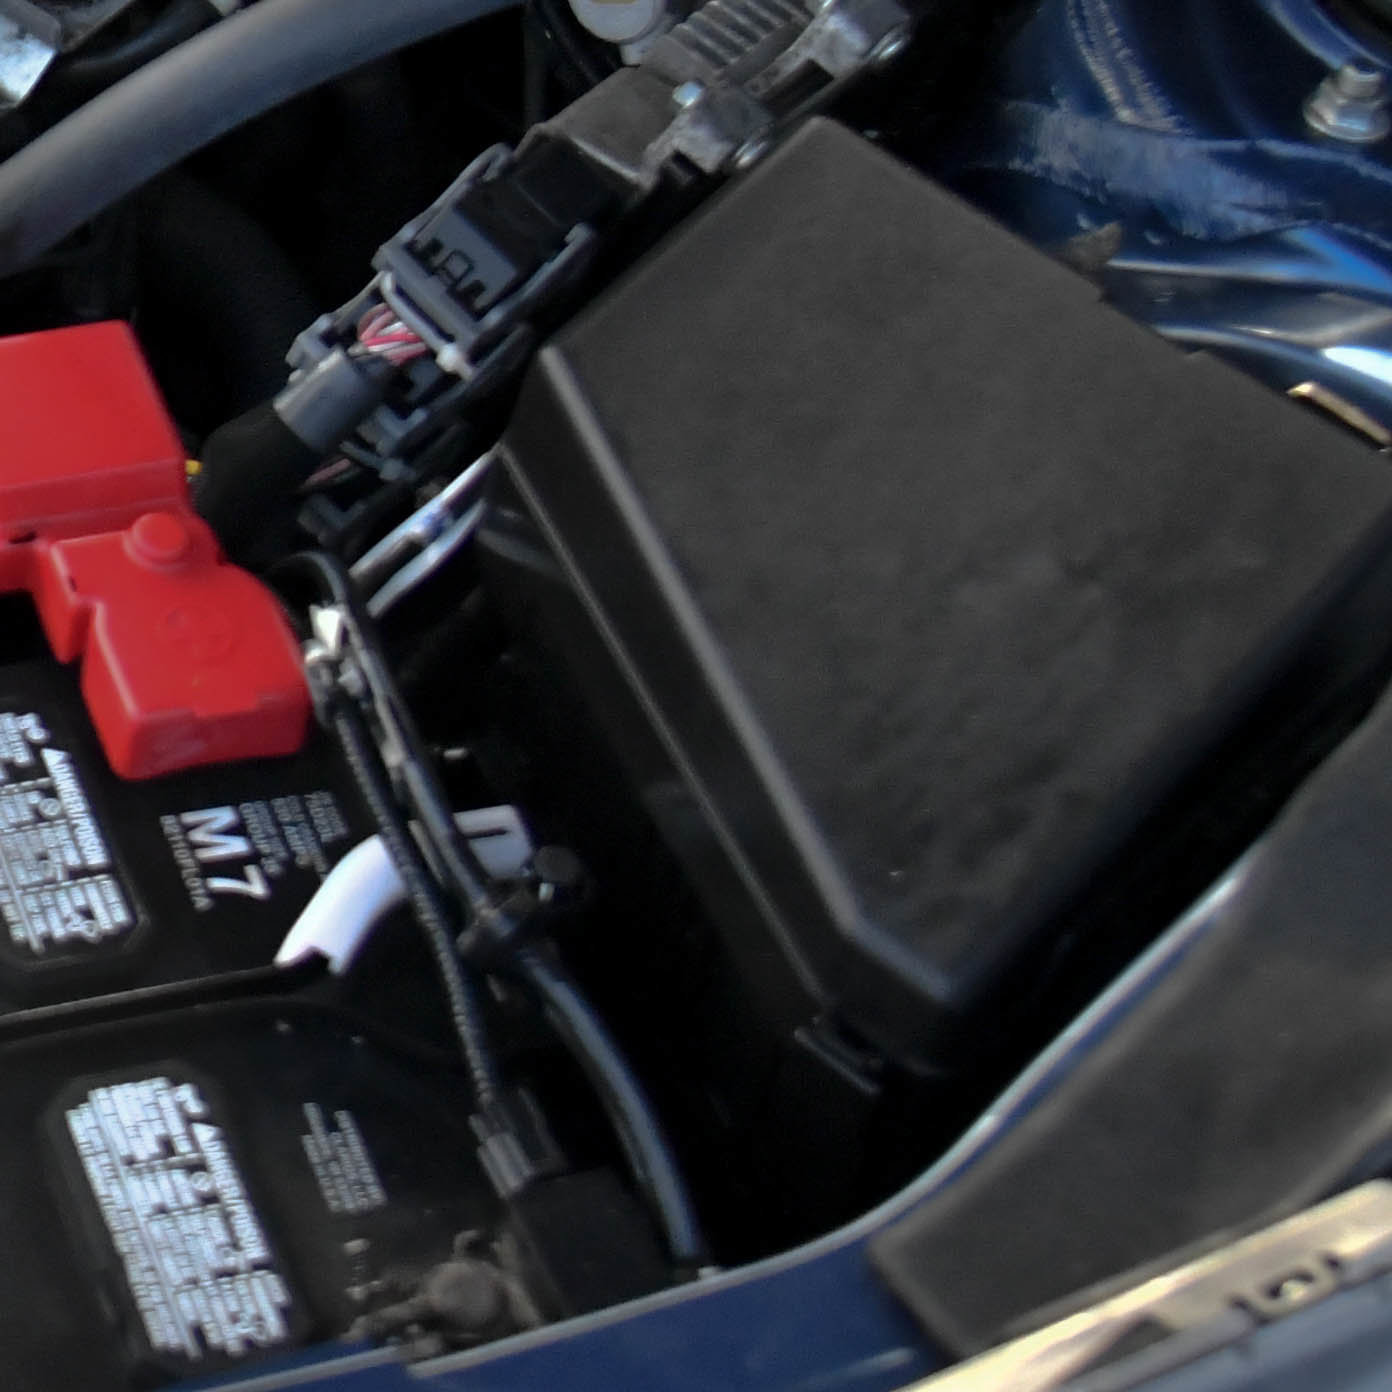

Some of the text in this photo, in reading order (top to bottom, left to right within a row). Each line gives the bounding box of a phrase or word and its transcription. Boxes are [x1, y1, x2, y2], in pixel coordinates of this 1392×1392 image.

[47, 763, 110, 866] DANGER/POISON
[179, 805, 271, 895] M7
[202, 1138, 267, 1260] DANGER/POISON
